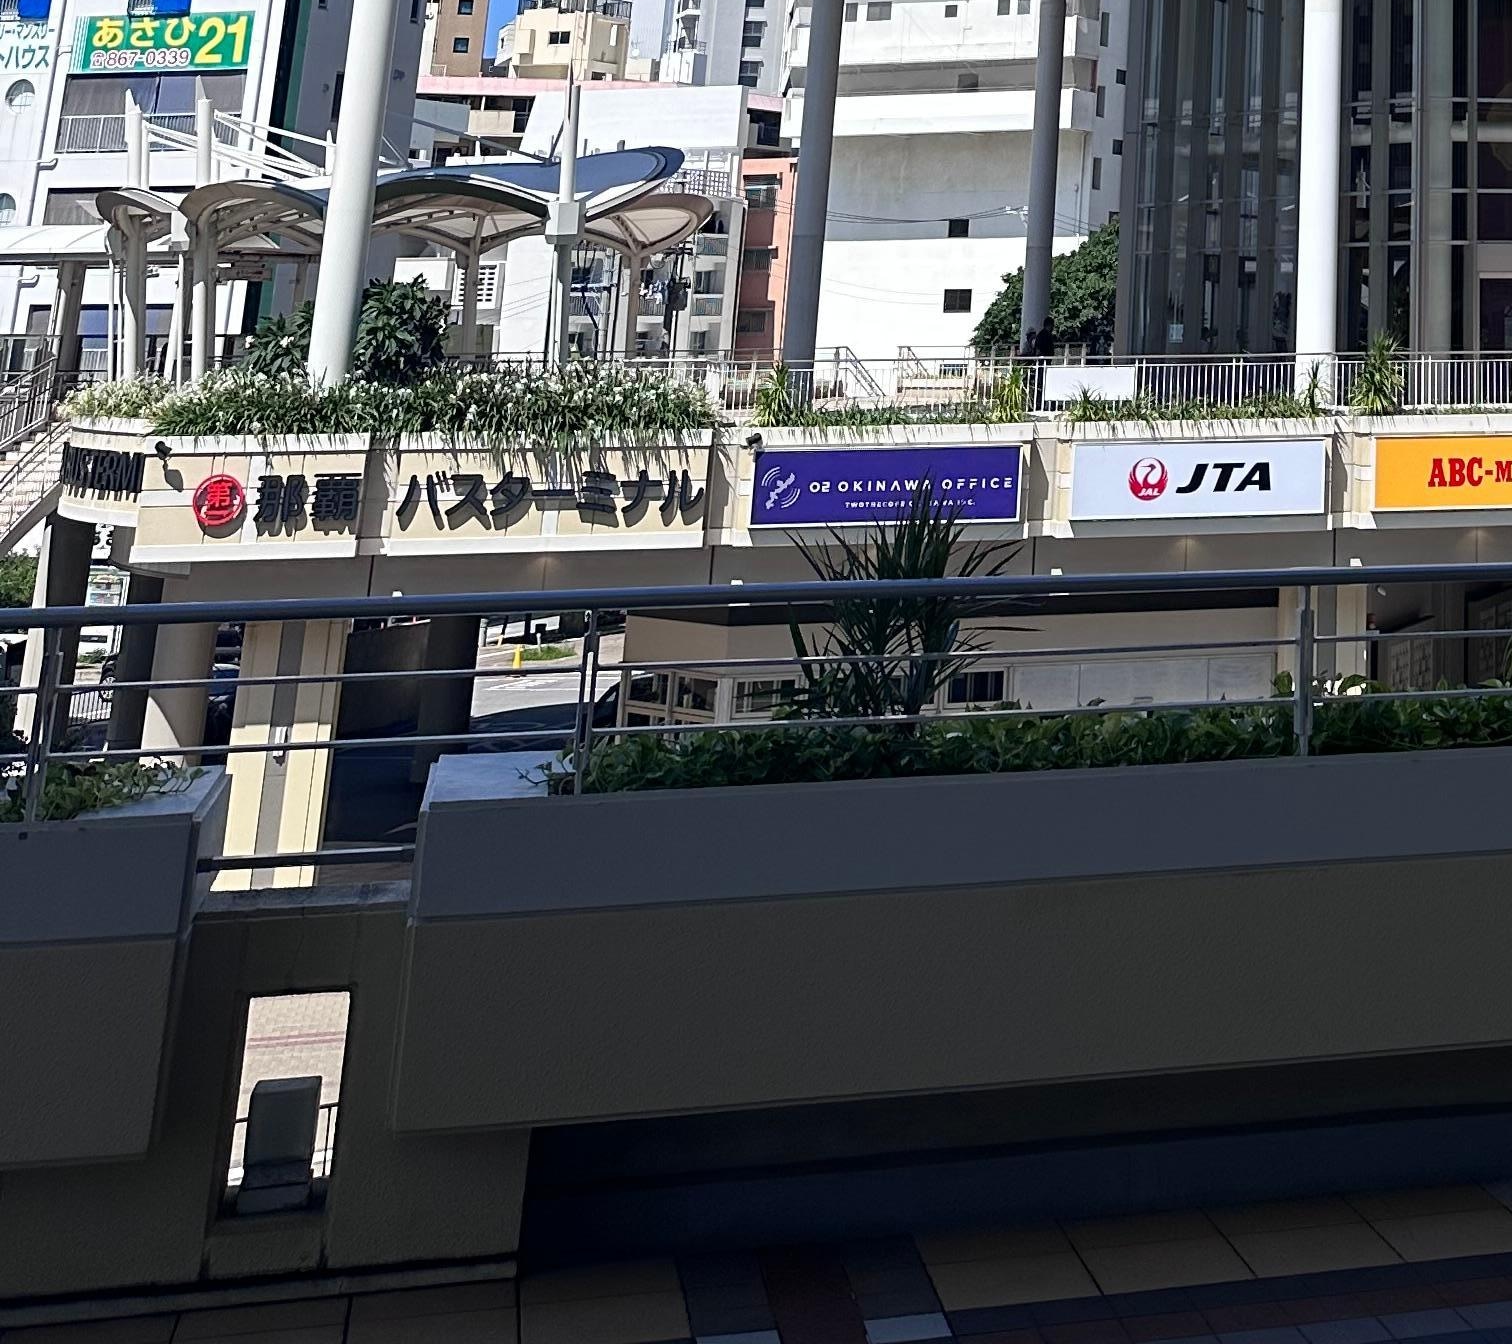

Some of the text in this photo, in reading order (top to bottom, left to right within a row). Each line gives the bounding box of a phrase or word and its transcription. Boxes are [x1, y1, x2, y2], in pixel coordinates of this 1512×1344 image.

[0, 45, 50, 69] ハウス
[106, 48, 190, 67] 867-0339
[941, 477, 1014, 491] OFFICE
[1175, 461, 1271, 494] JTA
[256, 469, 705, 523] 那覇 バスターミナル
[1138, 488, 1161, 497] JAL
